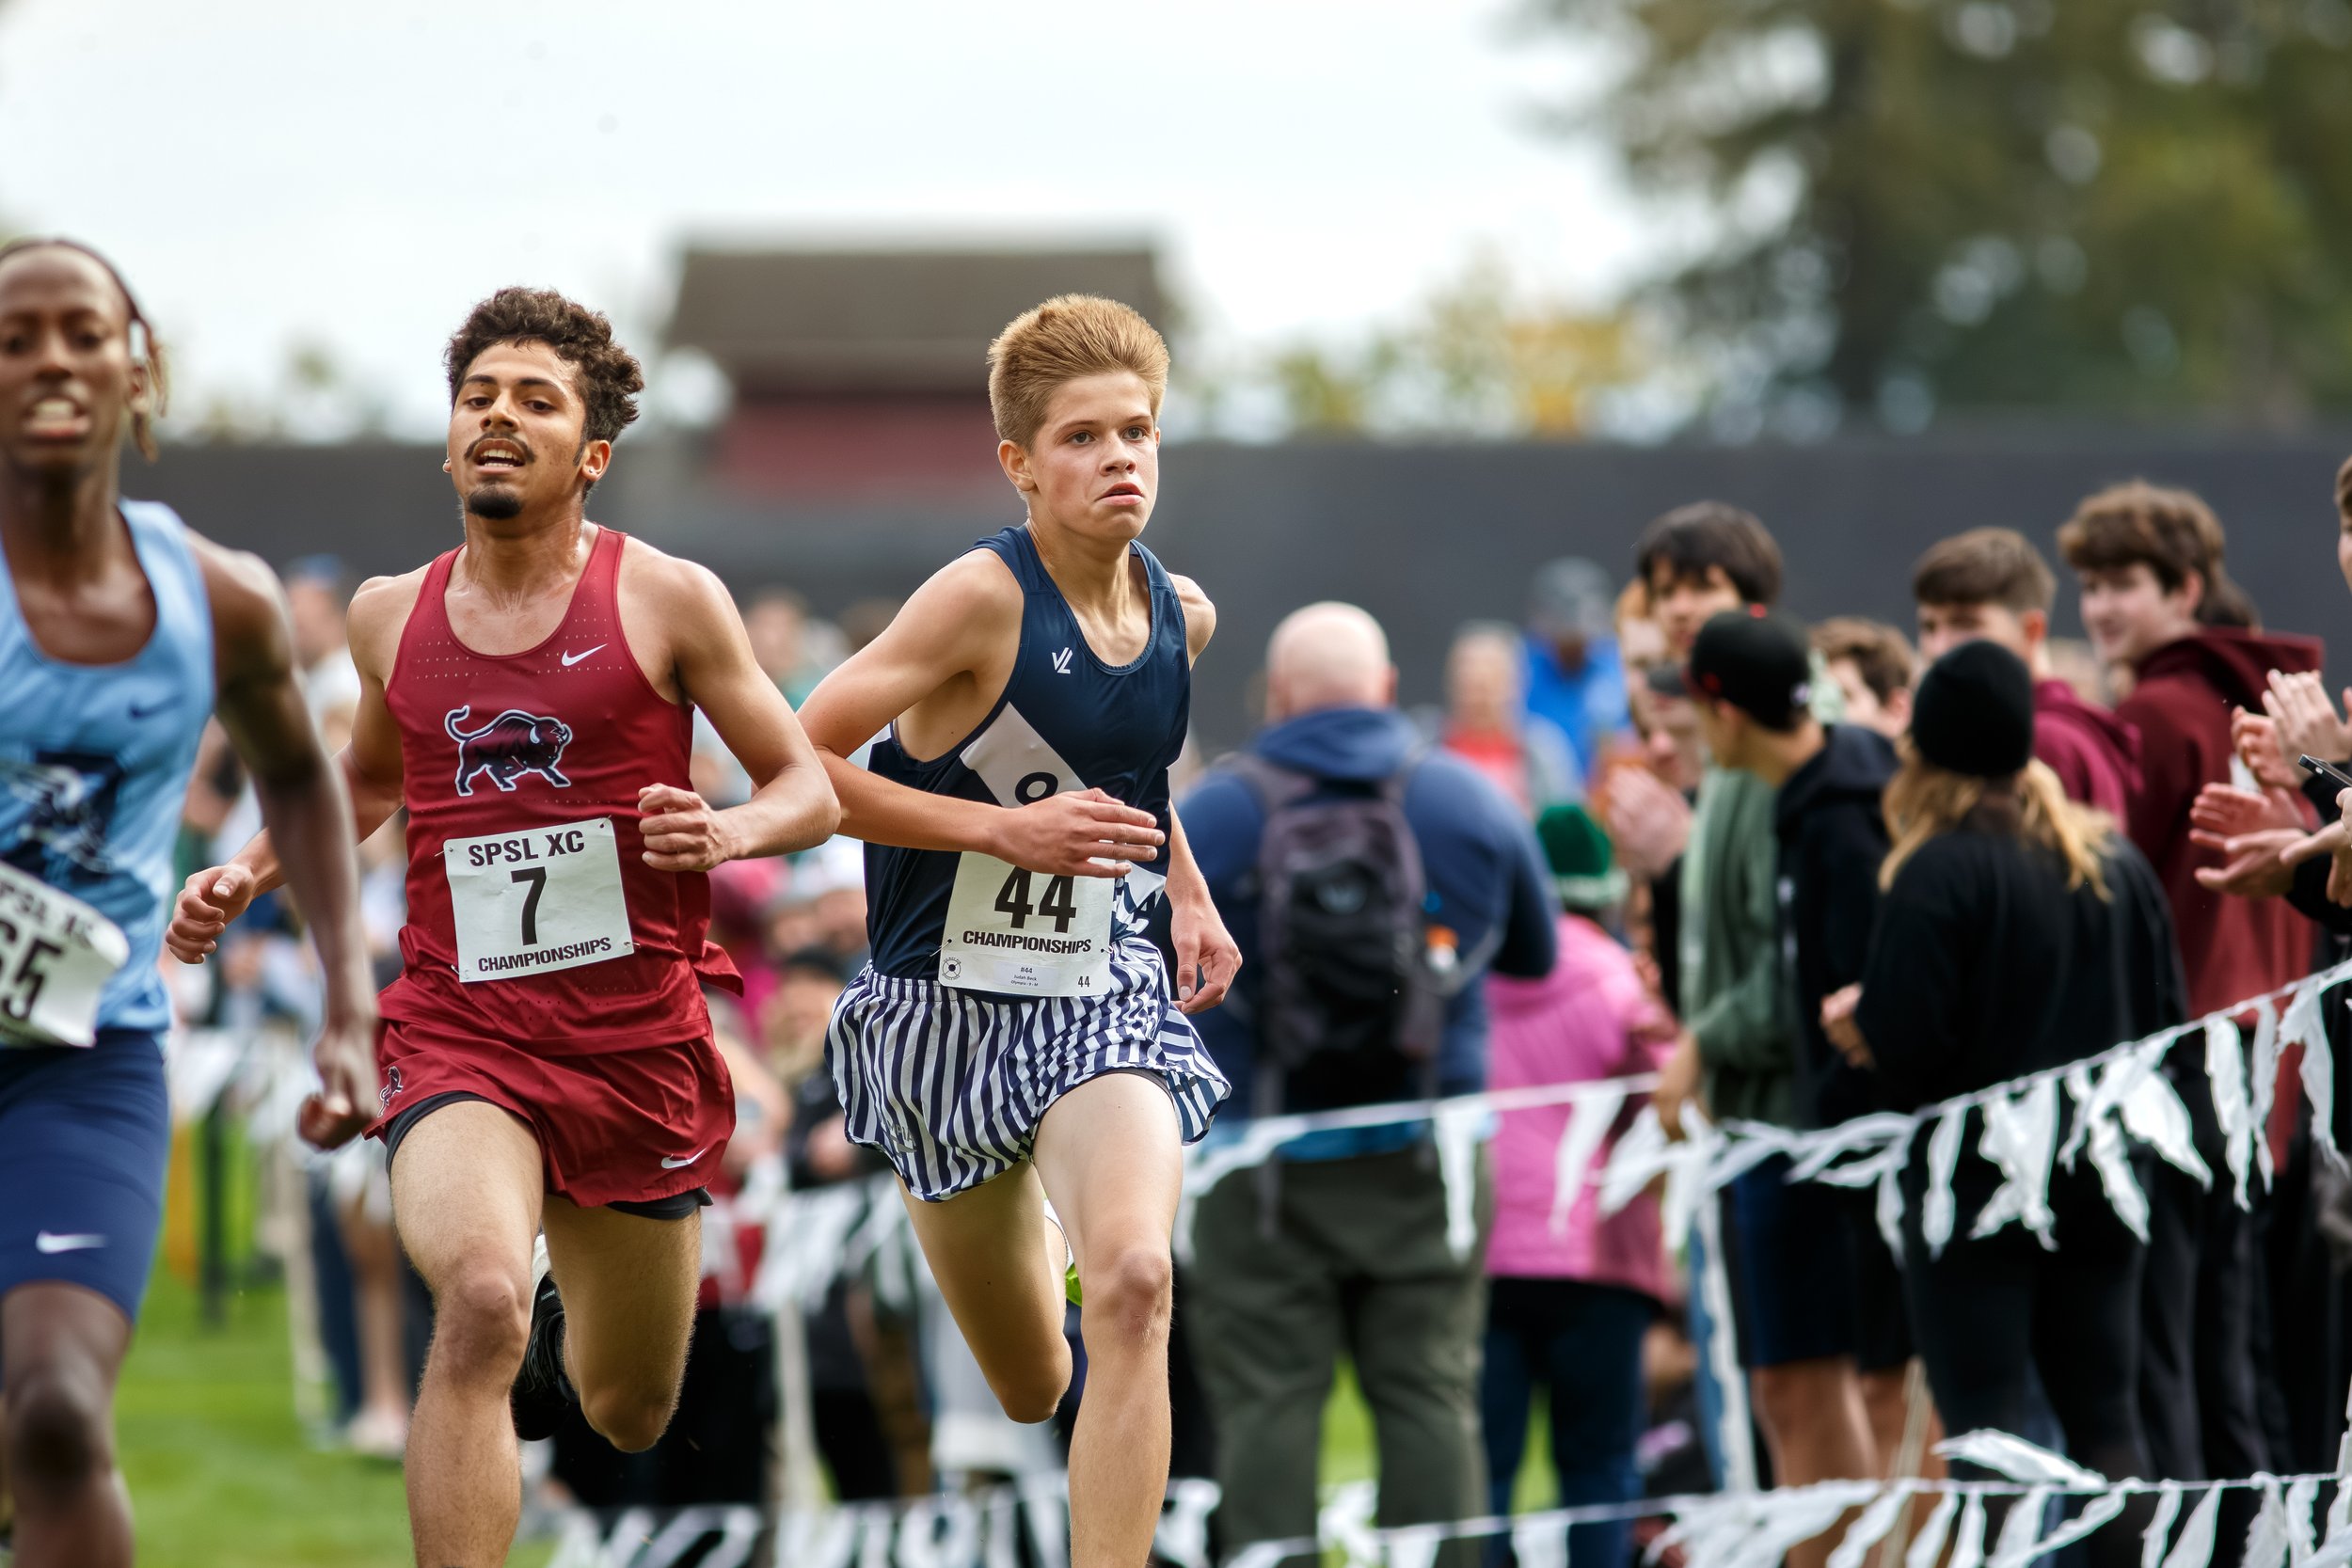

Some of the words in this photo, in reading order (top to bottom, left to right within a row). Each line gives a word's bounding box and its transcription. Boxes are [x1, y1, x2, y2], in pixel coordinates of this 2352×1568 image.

[468, 837, 539, 866] SPSL
[545, 830, 585, 857] XC
[510, 865, 548, 946] 7
[994, 864, 1077, 934] 44
[478, 937, 612, 973] CHAMPIONSHIPS
[962, 930, 1092, 955] CHAMPIONSHIPS
[1077, 975, 1090, 988] 44
